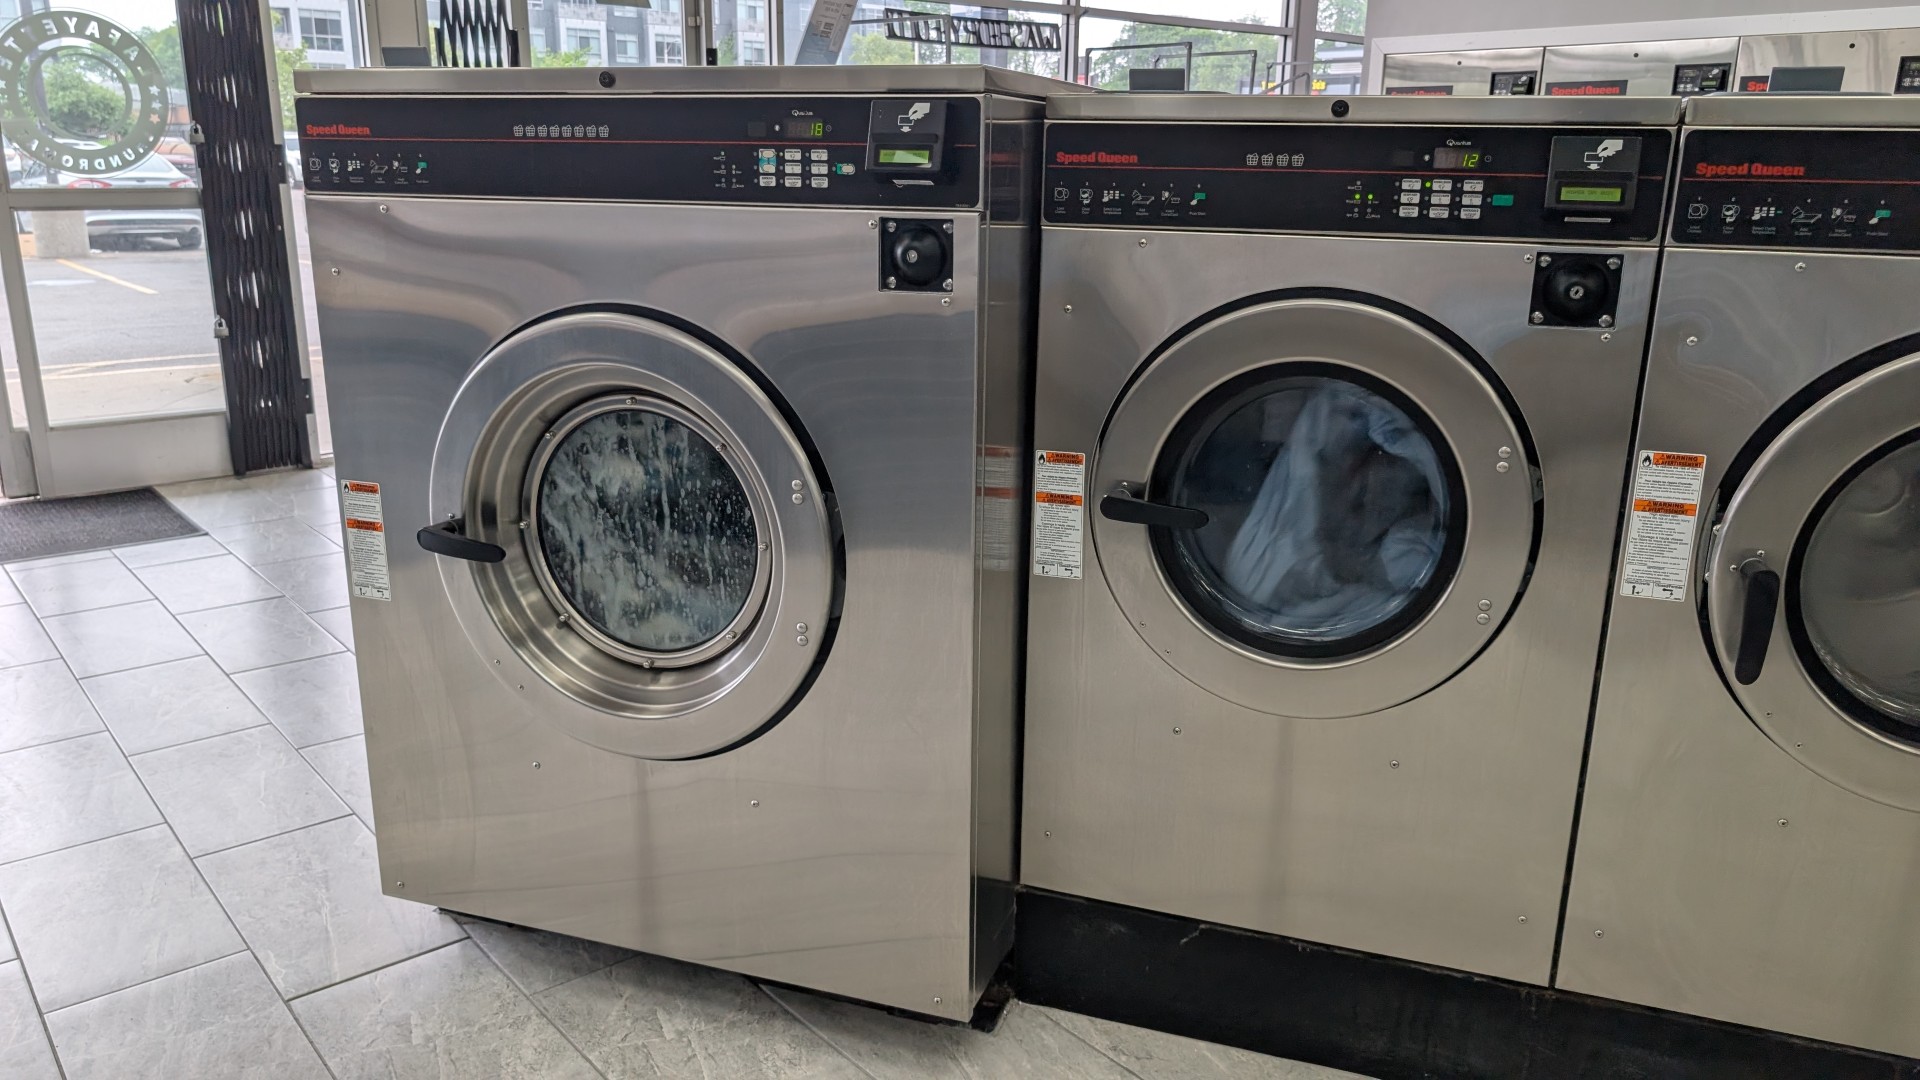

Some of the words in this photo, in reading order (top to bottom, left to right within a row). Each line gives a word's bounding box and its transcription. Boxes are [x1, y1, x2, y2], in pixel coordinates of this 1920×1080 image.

[1552, 86, 1585, 96] Speed
[1585, 85, 1620, 95] Queen
[306, 124, 337, 136] Speed
[338, 124, 370, 135] Queen
[811, 122, 823, 136] 18
[1056, 151, 1096, 164] Speed
[1098, 151, 1139, 164] Queen
[1463, 154, 1479, 168] 12
[1696, 162, 1749, 177] Speed
[1751, 162, 1805, 177] Queen
[1665, 454, 1698, 462] WARNING
[1652, 501, 1685, 509] WARNING
